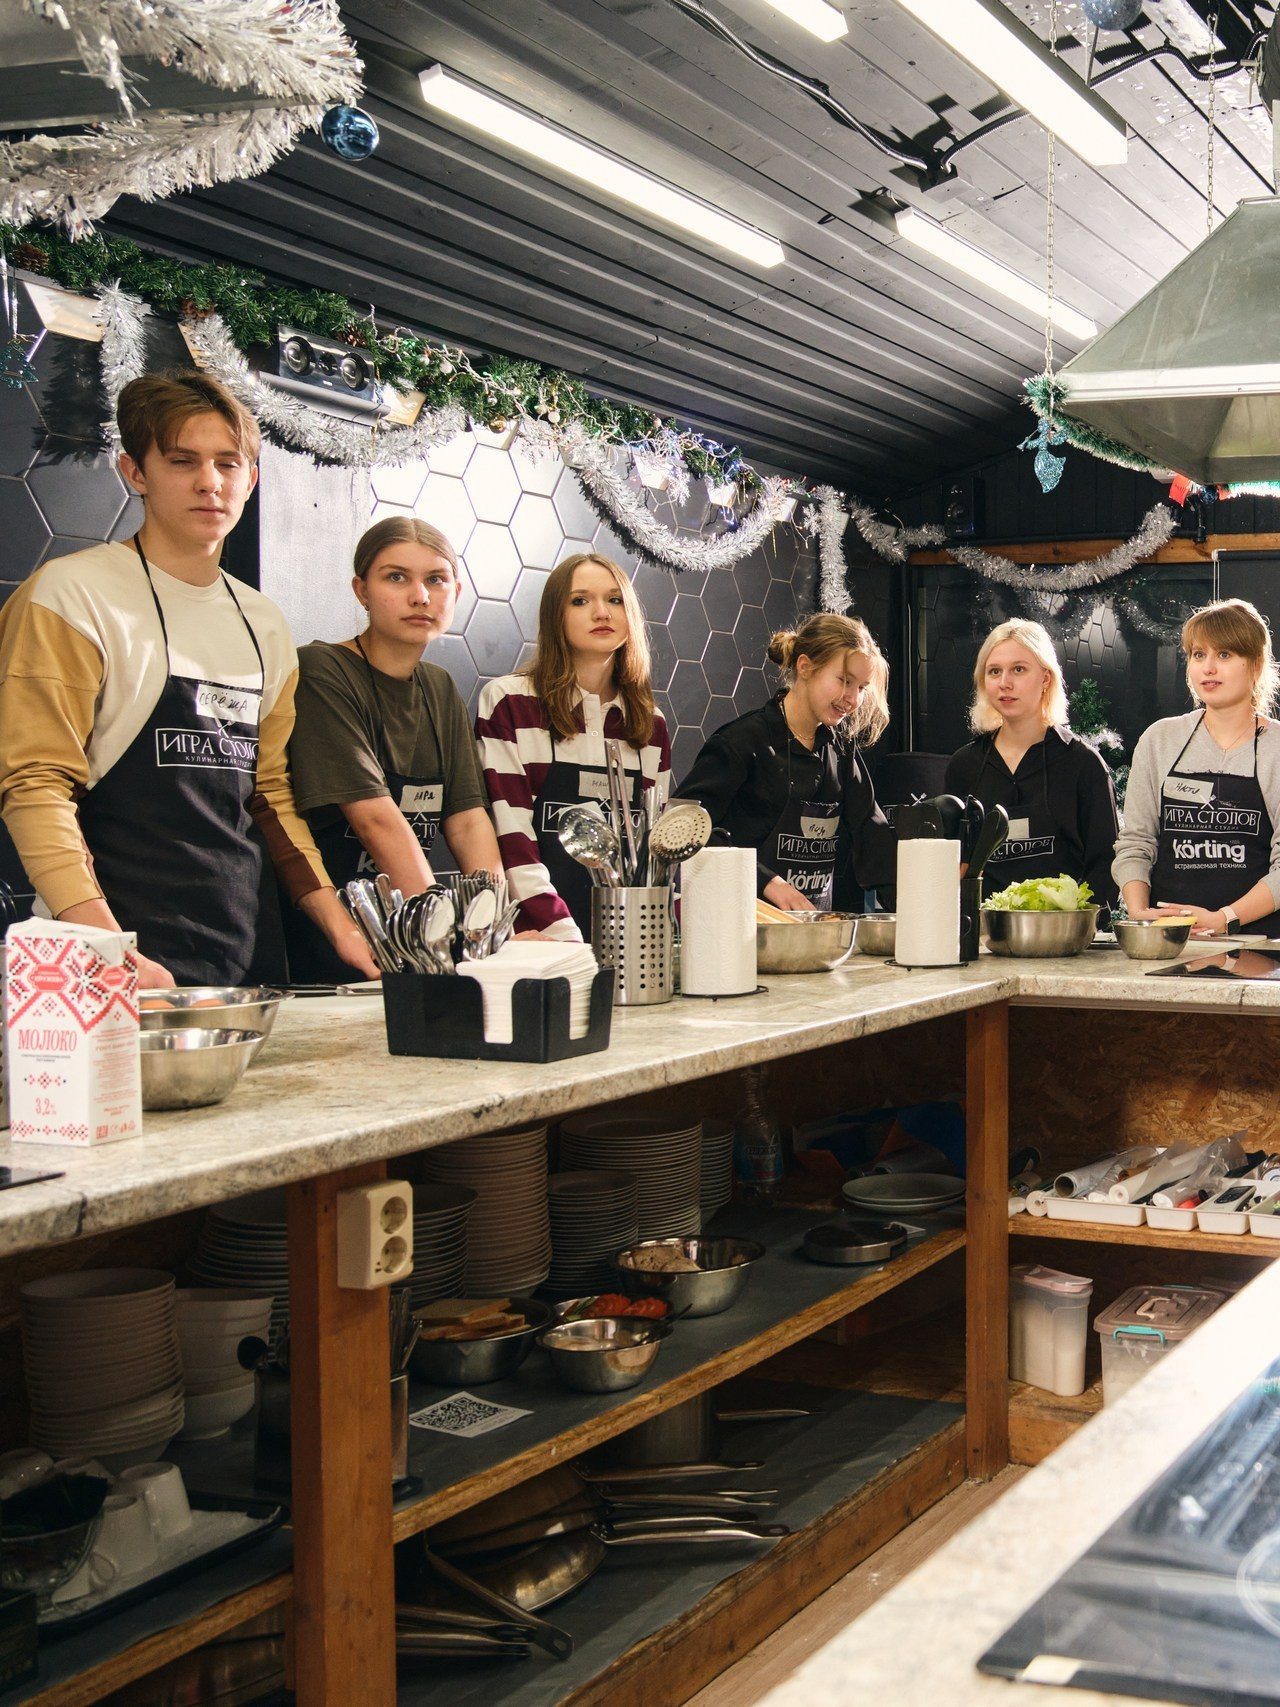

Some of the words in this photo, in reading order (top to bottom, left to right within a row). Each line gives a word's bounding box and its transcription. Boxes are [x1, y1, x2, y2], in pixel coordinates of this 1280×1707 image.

[199, 692, 248, 712] СЕРЁЖА
[162, 733, 215, 755] ИГРА
[219, 737, 259, 760] СТОЛО
[185, 755, 237, 765] КУЛИНАРНАЯ
[1165, 808, 1195, 823] ИГРА
[1198, 810, 1257, 826] СТОЛОВ
[781, 837, 809, 853] ИГРА
[810, 839, 839, 854] СТОЛО
[1173, 838, 1246, 863] körting
[1174, 862, 1218, 871] встраиваемая
[787, 868, 833, 892] körting
[18, 1029, 78, 1052] МОЛОКО
